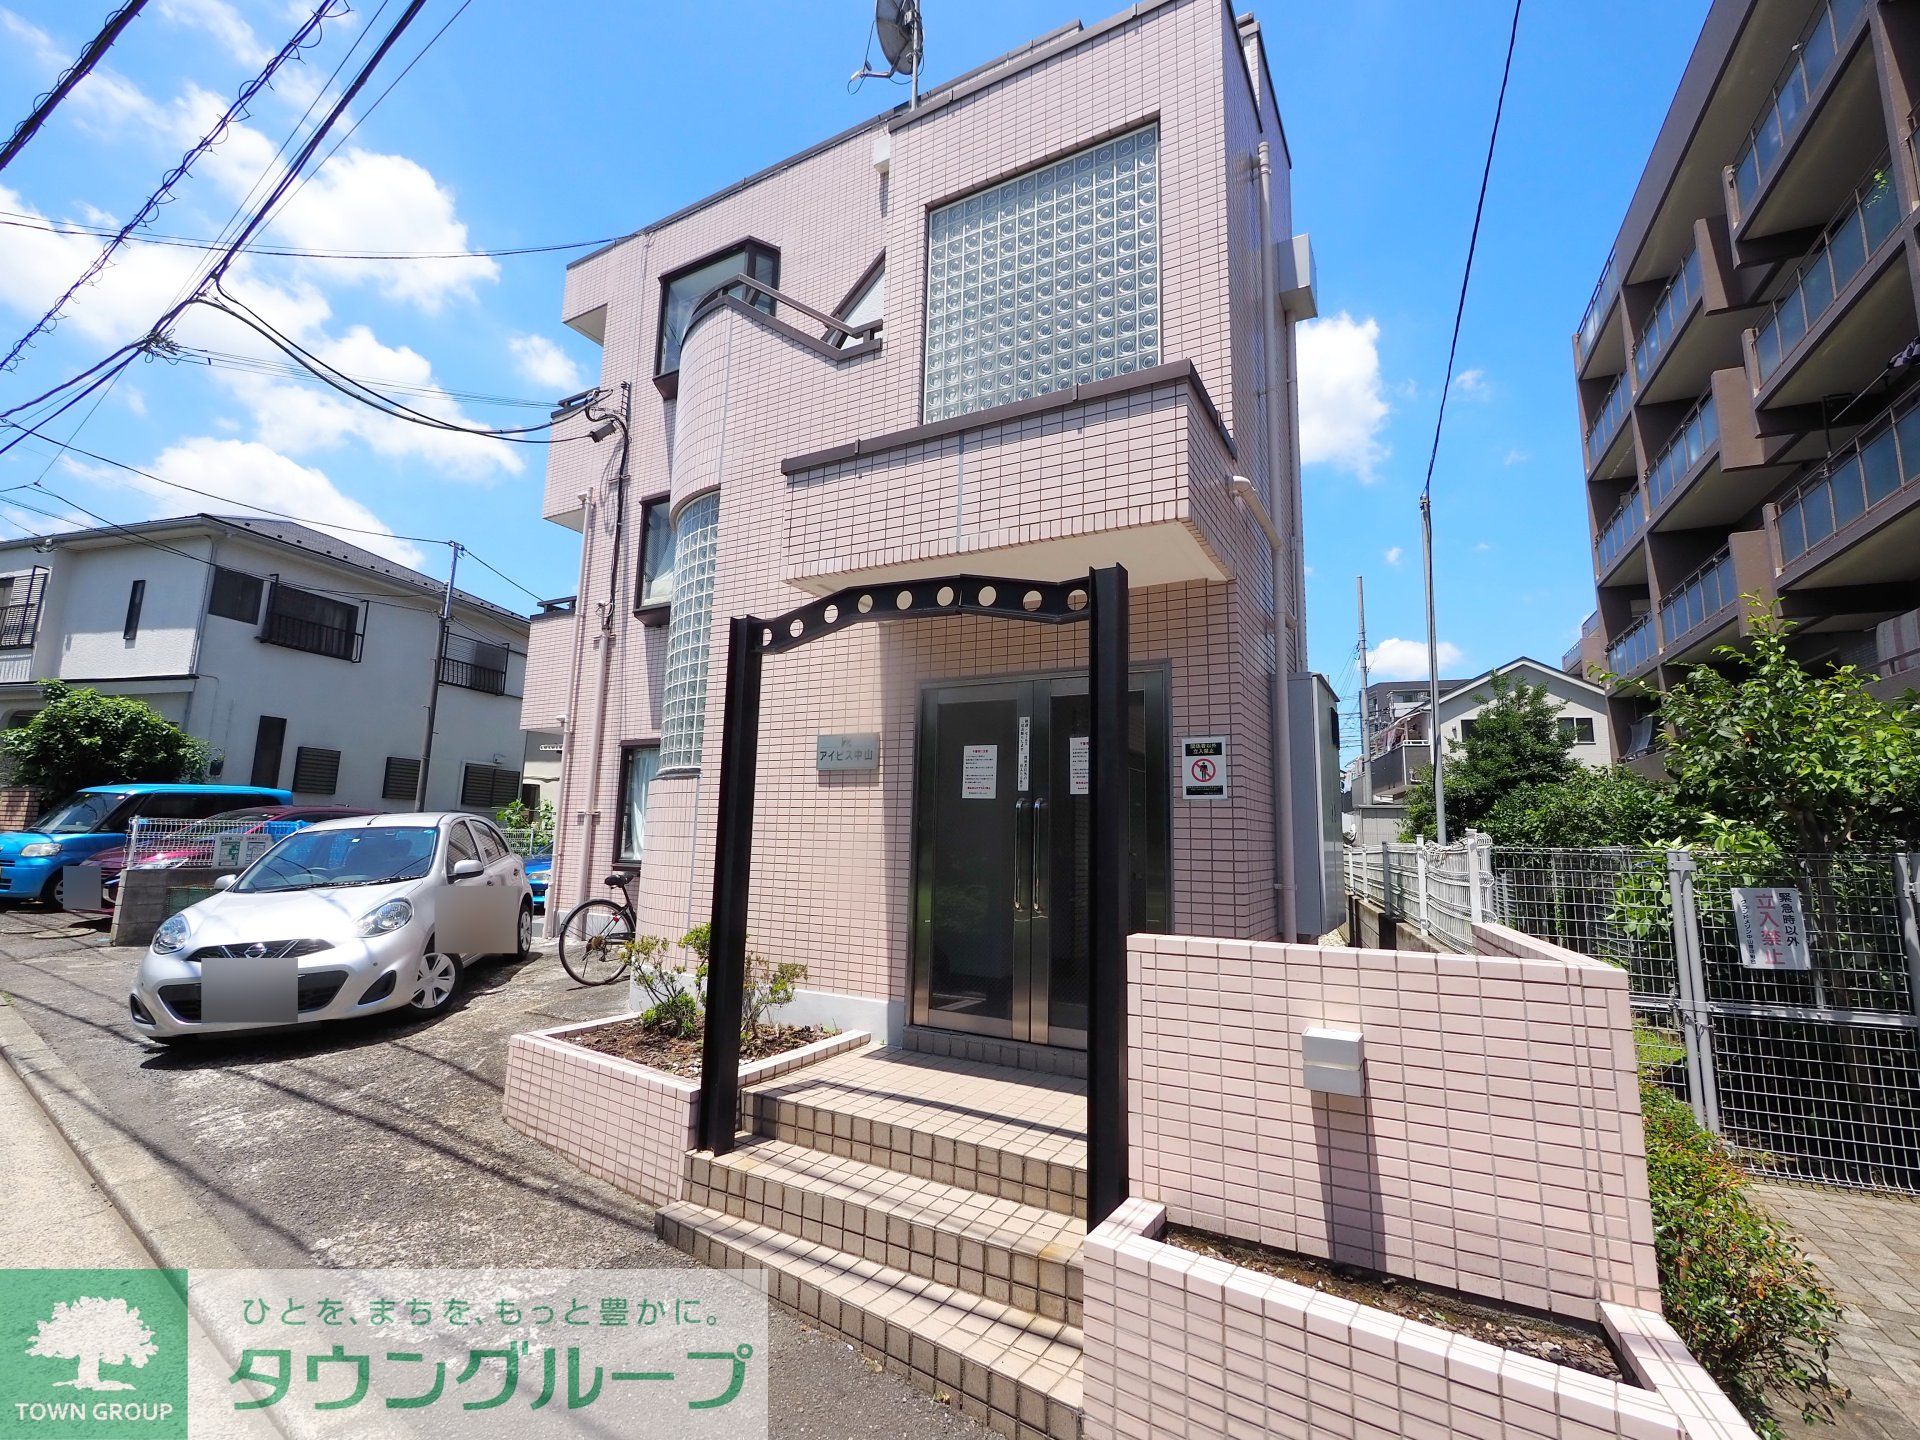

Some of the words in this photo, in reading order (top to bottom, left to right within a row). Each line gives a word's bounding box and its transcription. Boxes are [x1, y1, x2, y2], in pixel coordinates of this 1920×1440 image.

[1755, 893, 1786, 965] 立入禁止
[1779, 892, 1800, 947] 緊急時以外
